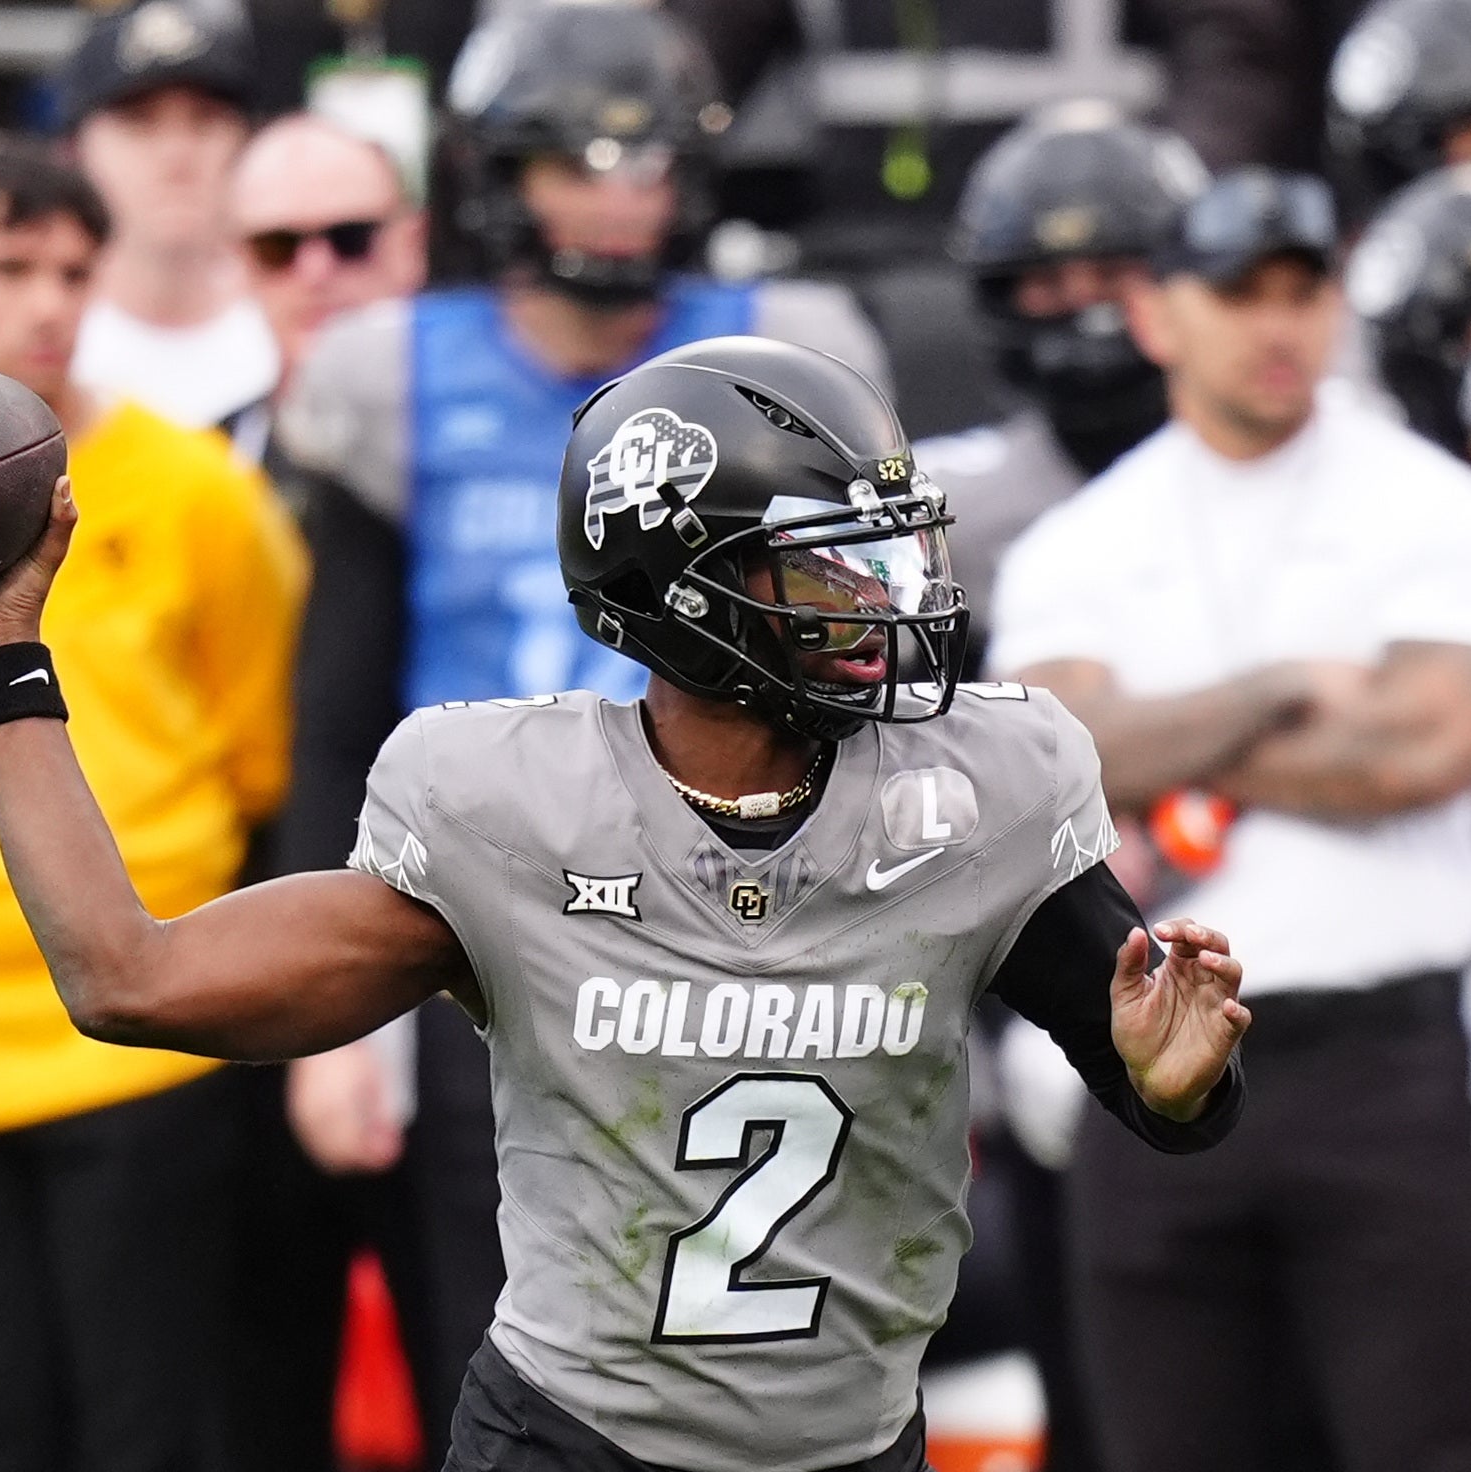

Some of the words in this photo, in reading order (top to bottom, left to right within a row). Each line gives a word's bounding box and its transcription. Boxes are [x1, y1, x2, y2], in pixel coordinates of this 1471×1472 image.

[877, 458, 907, 481] S2S
[922, 775, 951, 840] L
[572, 976, 930, 1060] COLORADO
[650, 1071, 856, 1345] 2
